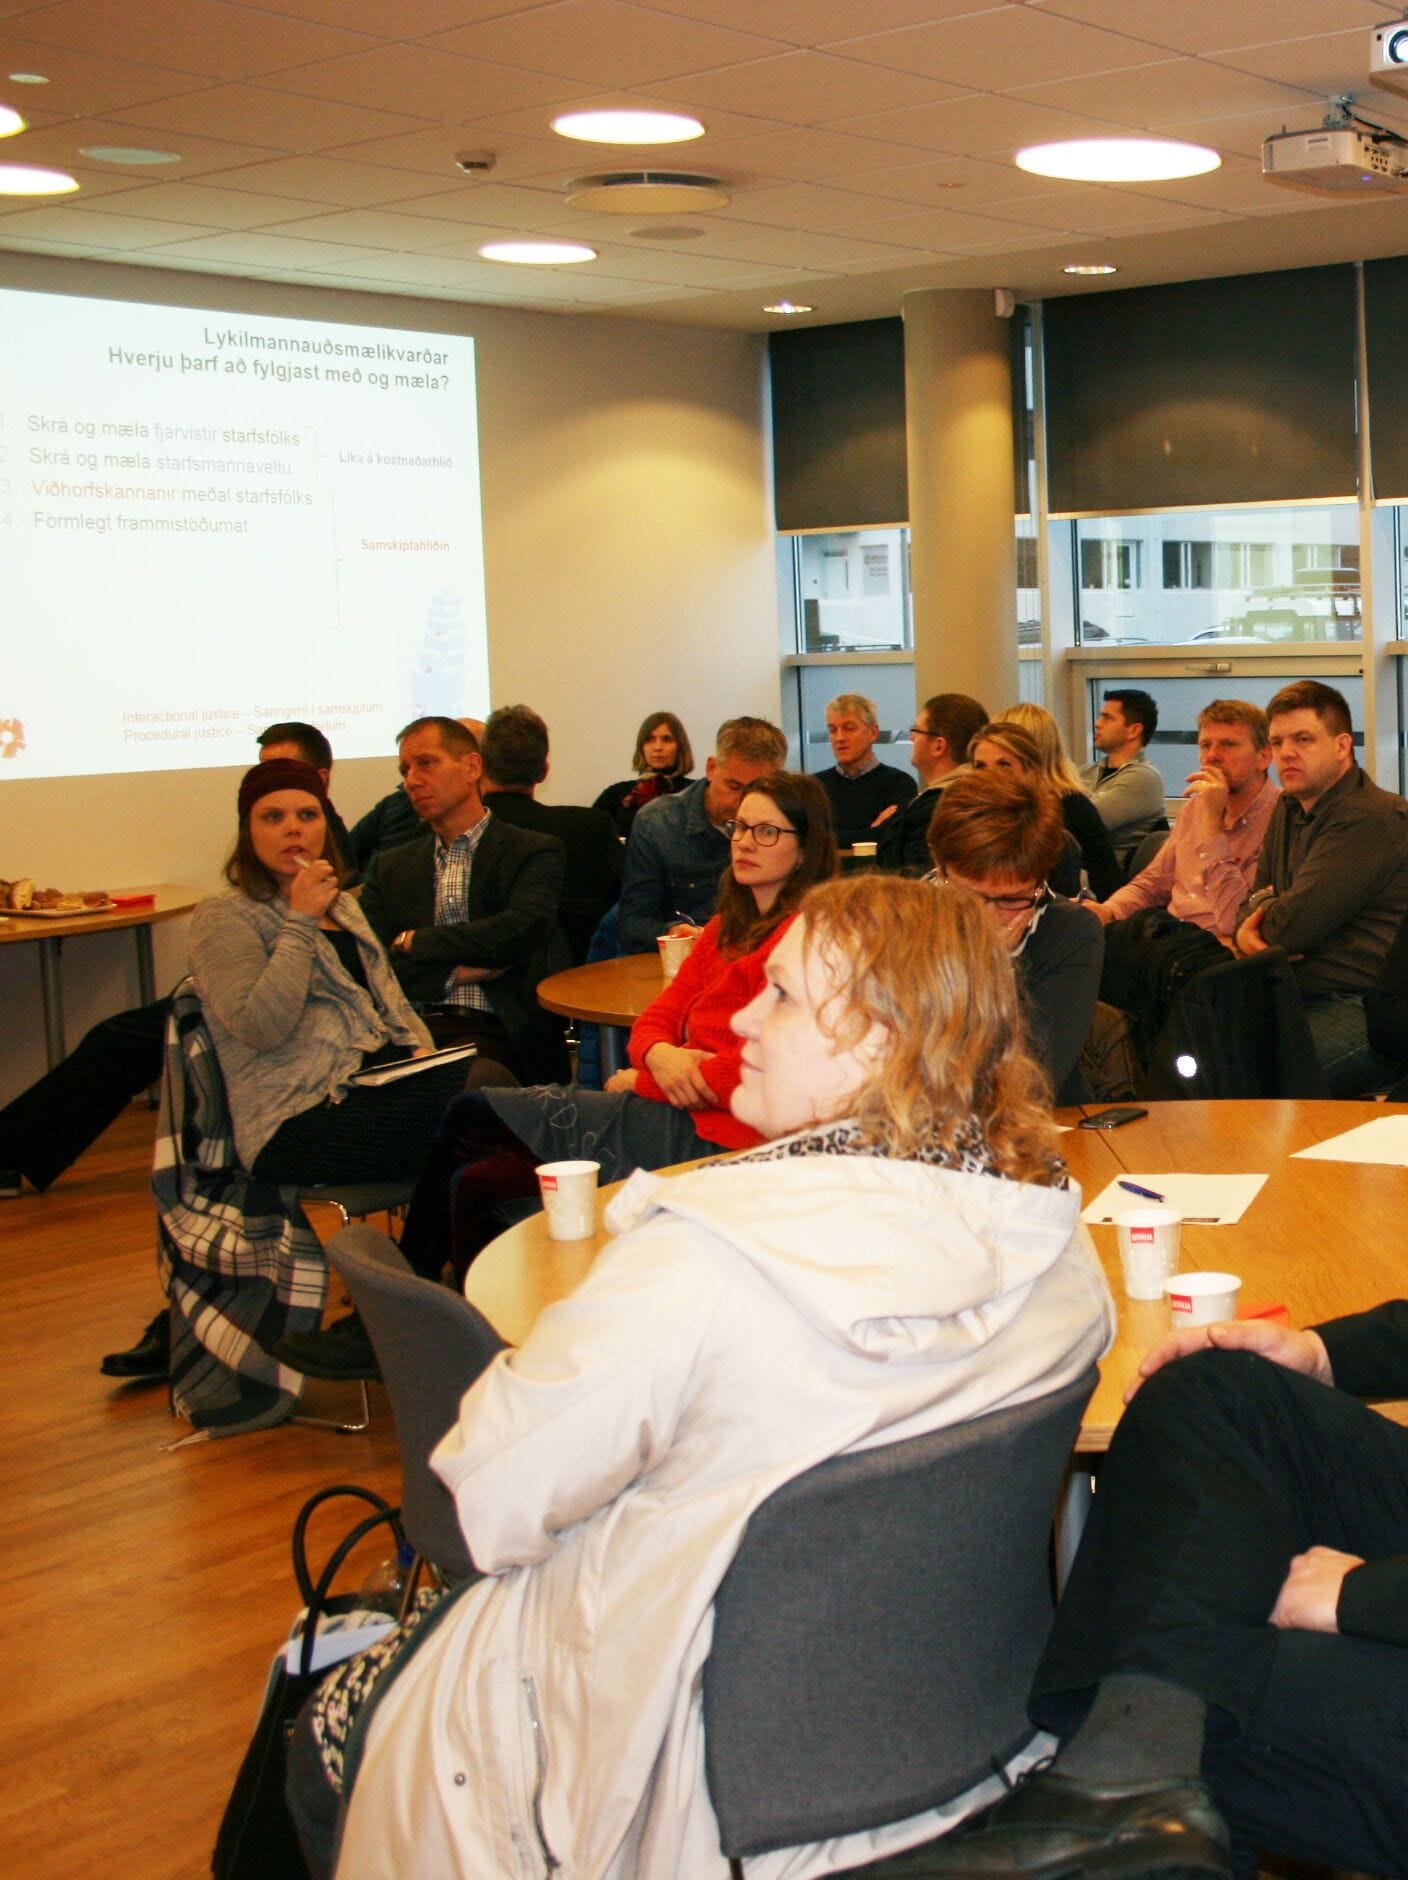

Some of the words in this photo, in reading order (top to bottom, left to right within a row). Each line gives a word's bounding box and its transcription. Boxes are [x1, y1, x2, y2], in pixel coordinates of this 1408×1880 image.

[204, 327, 449, 366] Lykilmannauðsmælikvarðar
[108, 347, 173, 372] Hverju
[181, 352, 218, 374] þarf
[224, 359, 247, 375] að
[253, 360, 320, 382] fylgjast
[325, 366, 362, 384] með
[368, 373, 389, 390] og
[395, 373, 449, 391] mæla?
[27, 414, 68, 433] Skrá
[74, 421, 96, 439] og
[102, 421, 149, 438] mæla
[154, 423, 217, 443] fjarvistir
[222, 428, 300, 446] starfsfólks
[30, 447, 70, 465] Skrá
[76, 453, 97, 471] og
[103, 452, 151, 470] mæla
[156, 453, 291, 475] starfsmannaveltu
[30, 480, 175, 501] Viðhorfskannanir
[182, 486, 231, 503] meðal
[34, 511, 112, 534] Formlegt
[116, 514, 248, 533] frammistöðumat
[122, 709, 198, 723] Interactional
[201, 707, 240, 723] justice
[318, 702, 383, 716] samskiptum
[123, 728, 191, 742] Procedural
[194, 726, 233, 741] justice
